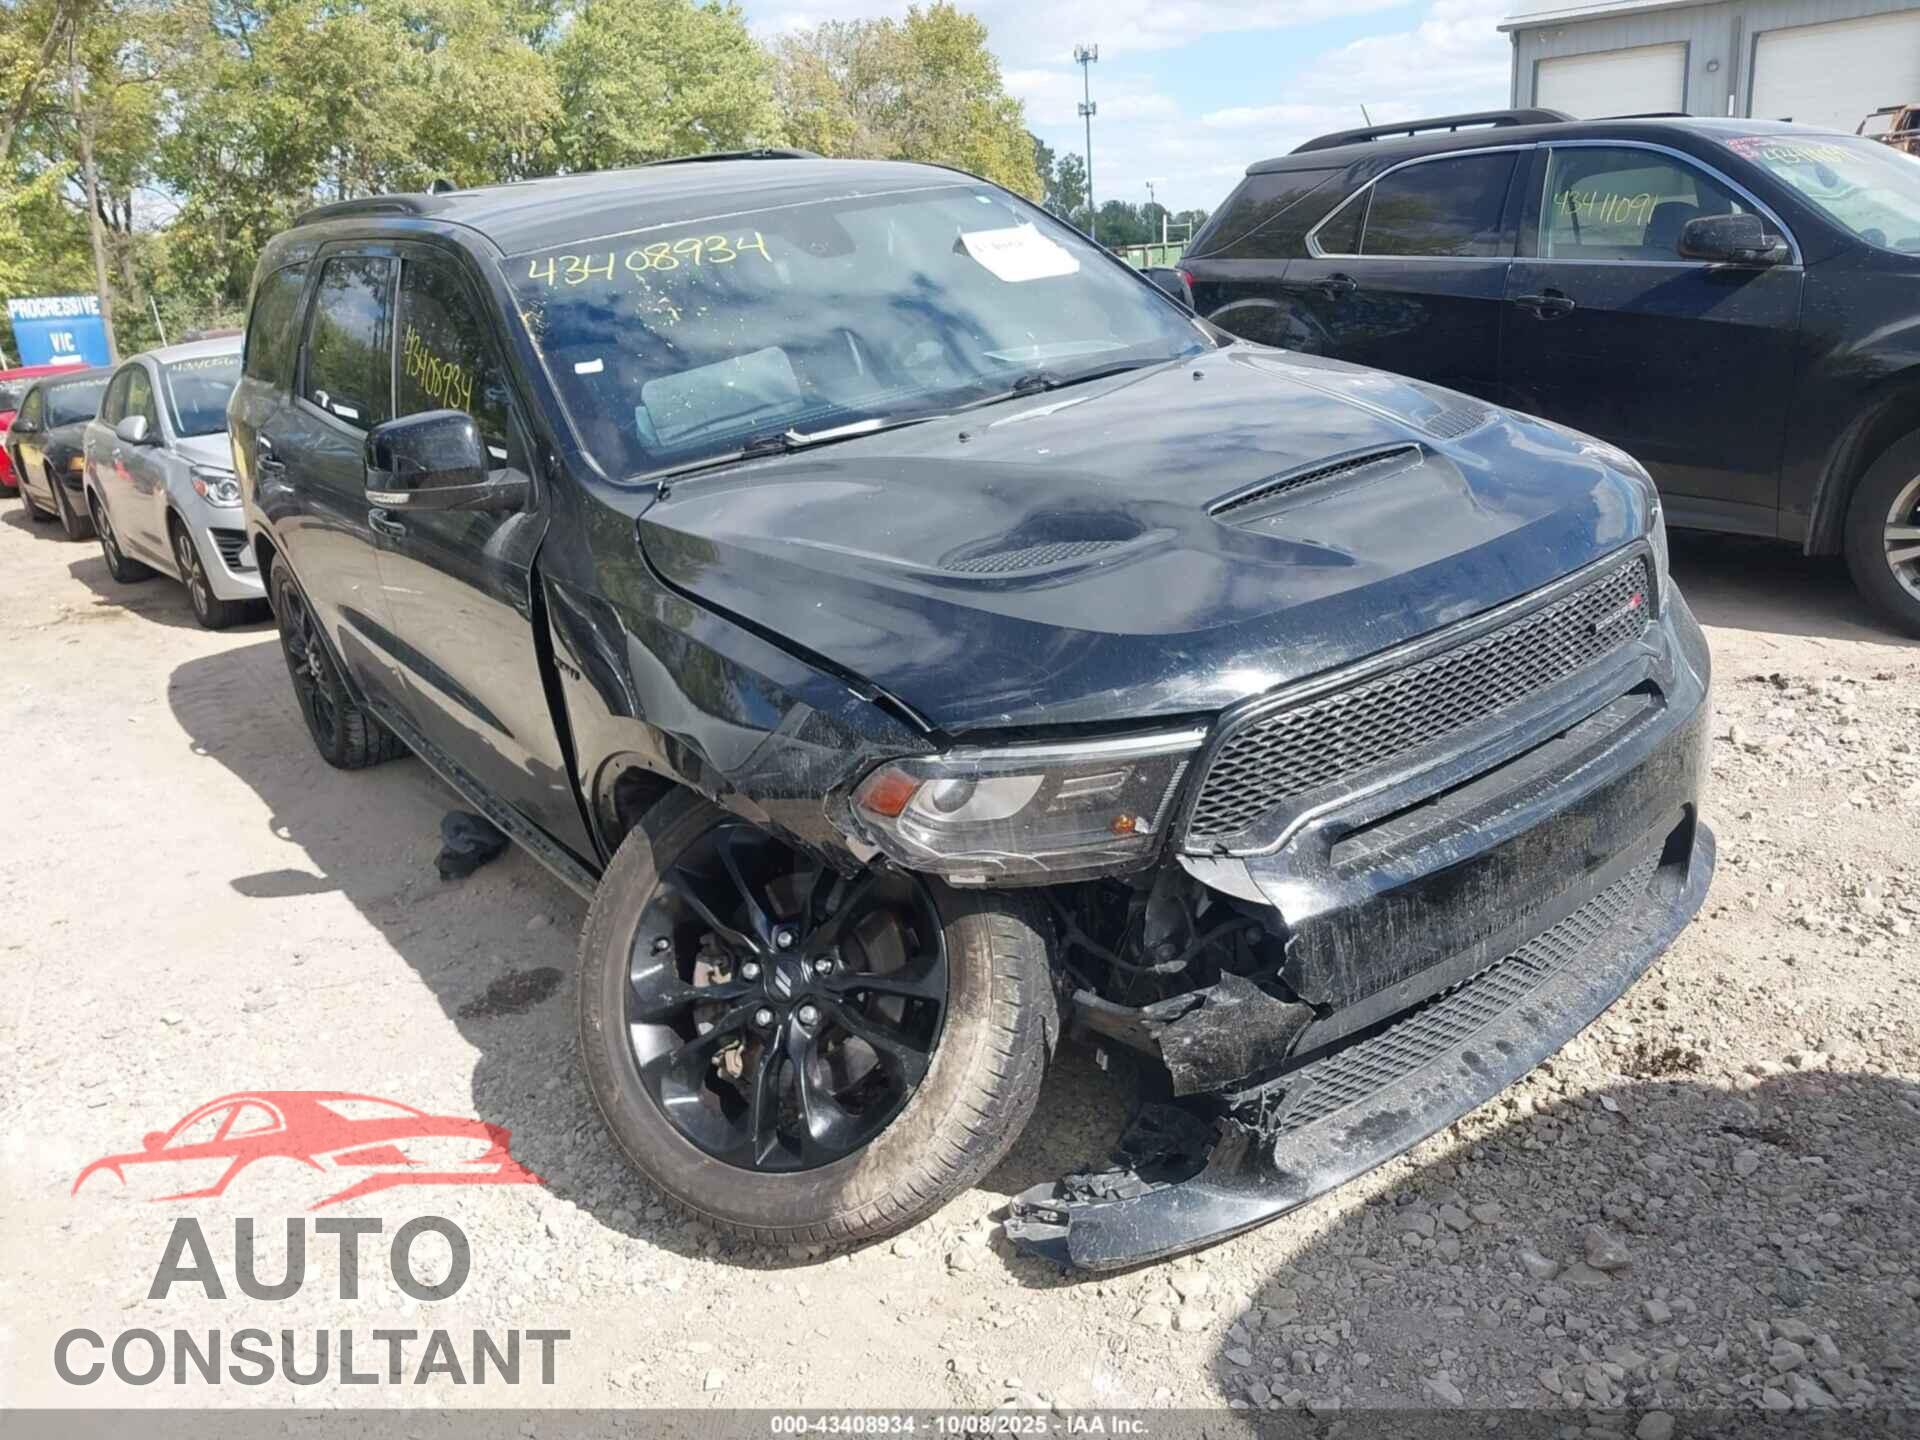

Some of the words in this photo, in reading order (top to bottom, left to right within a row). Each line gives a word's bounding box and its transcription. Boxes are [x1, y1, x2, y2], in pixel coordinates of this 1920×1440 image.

[7, 295, 101, 319] PROGRESSIVE
[49, 332, 75, 352] VIC
[404, 323, 473, 413] 43408934
